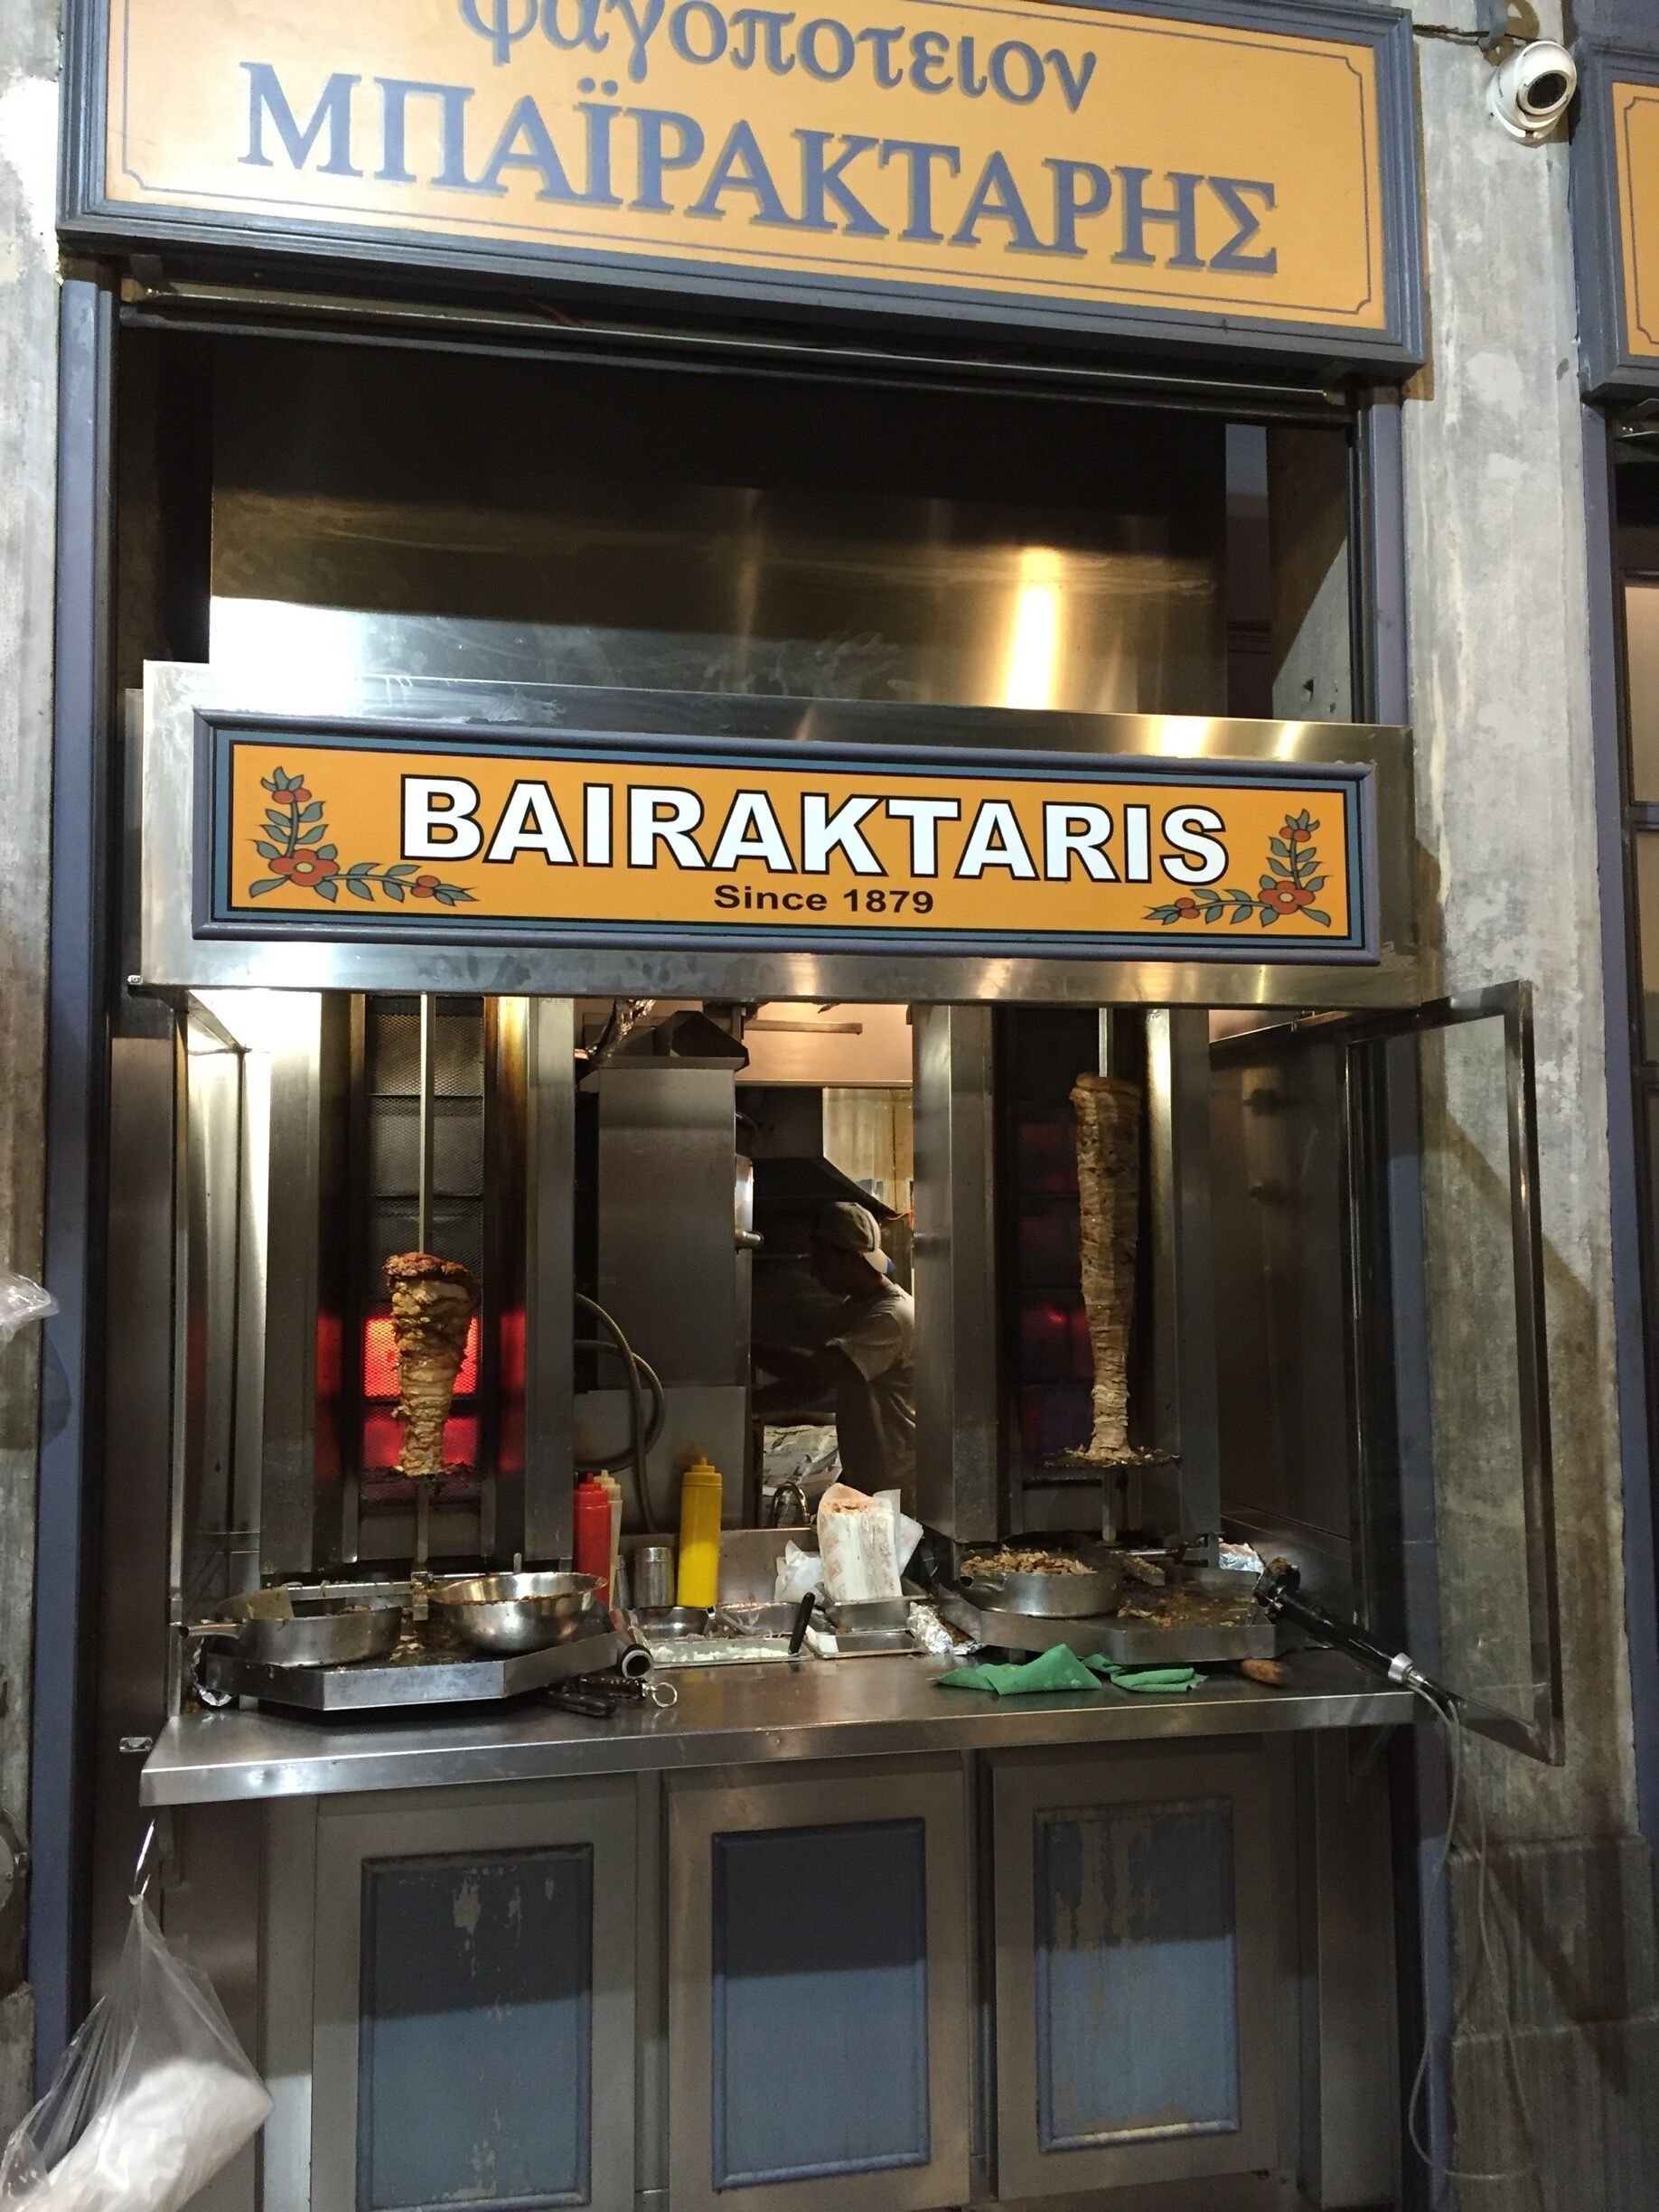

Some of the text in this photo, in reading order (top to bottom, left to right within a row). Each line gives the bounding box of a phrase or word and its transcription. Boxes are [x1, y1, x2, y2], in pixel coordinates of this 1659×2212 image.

[237, 61, 1279, 276] ΜΠΑΪΡΑΚΤΑΡΗΣ
[400, 773, 1229, 886] BAIRAKTARIS
[714, 885, 934, 914] Since 1879
